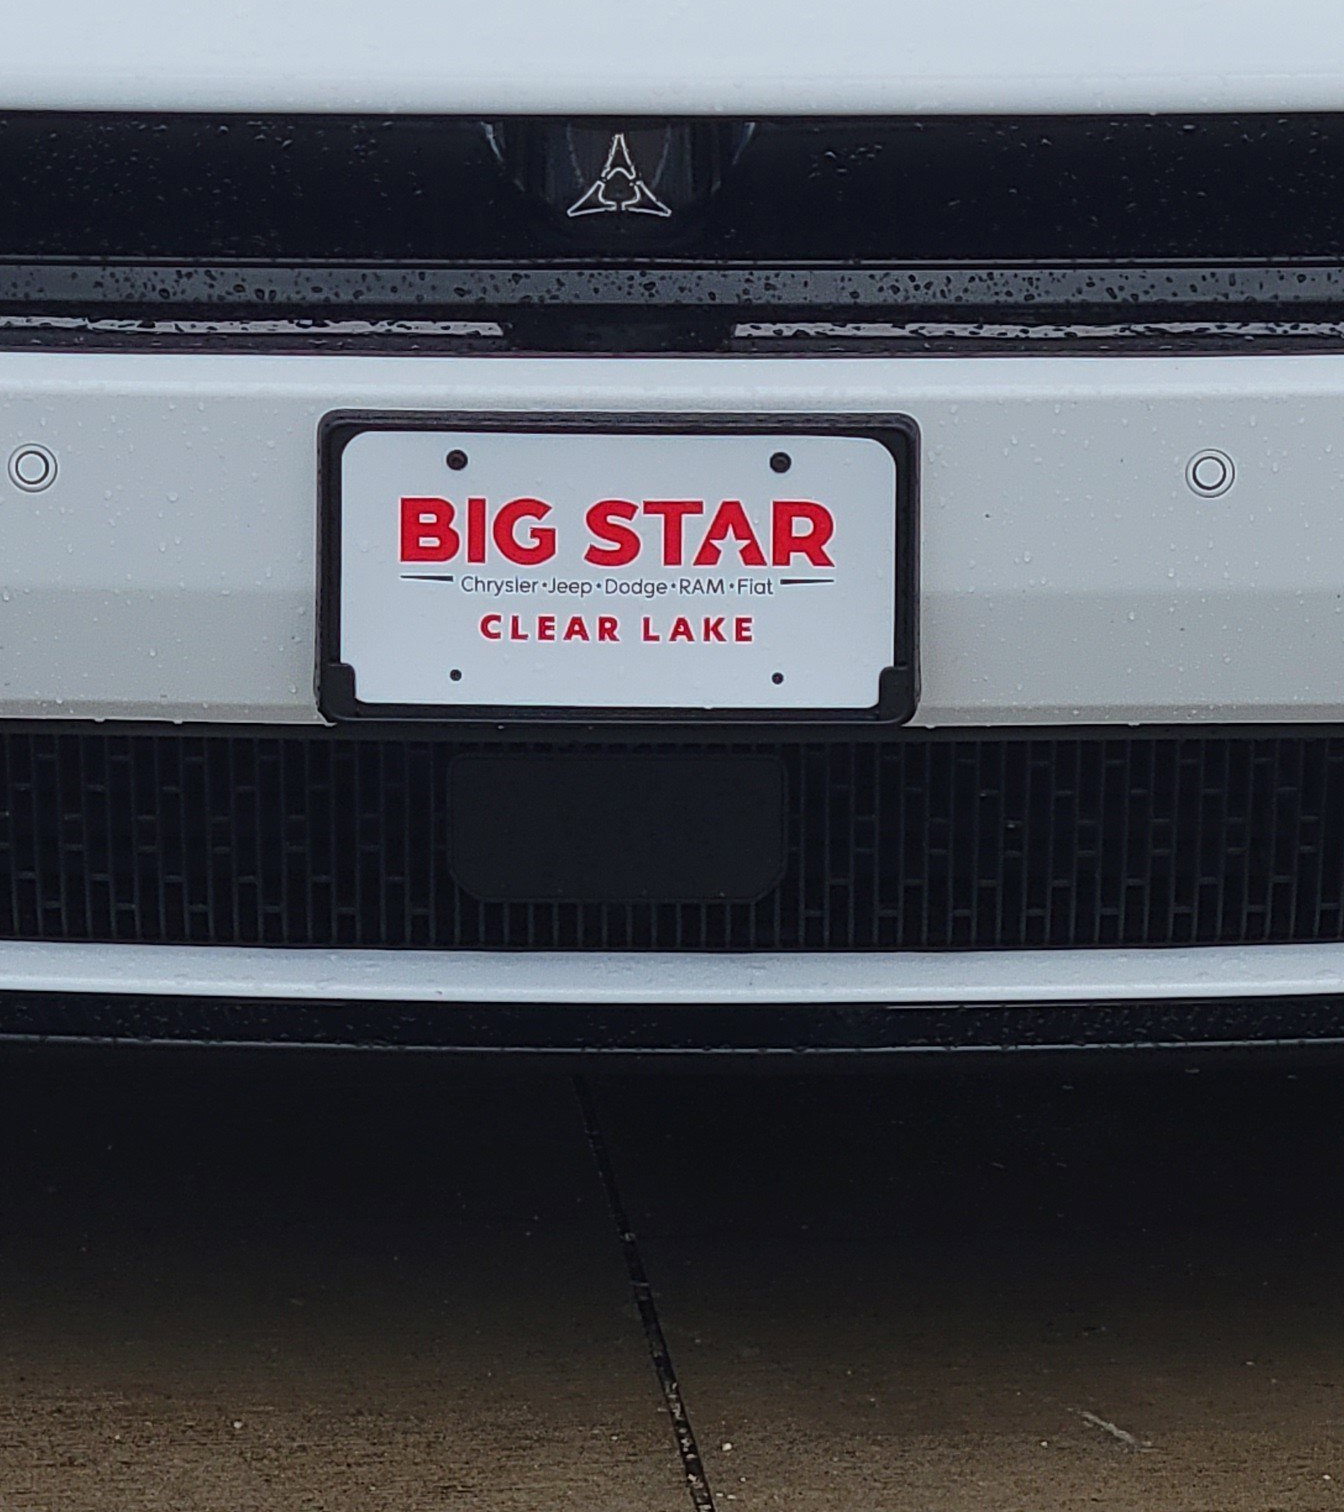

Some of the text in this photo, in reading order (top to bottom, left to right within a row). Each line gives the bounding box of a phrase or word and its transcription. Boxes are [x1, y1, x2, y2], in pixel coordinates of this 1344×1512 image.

[400, 497, 835, 568] BIG STAR
[460, 575, 774, 598] Chrysler Jeep Dodge RAM Fiat
[479, 614, 753, 643] CLEAR LAKE
